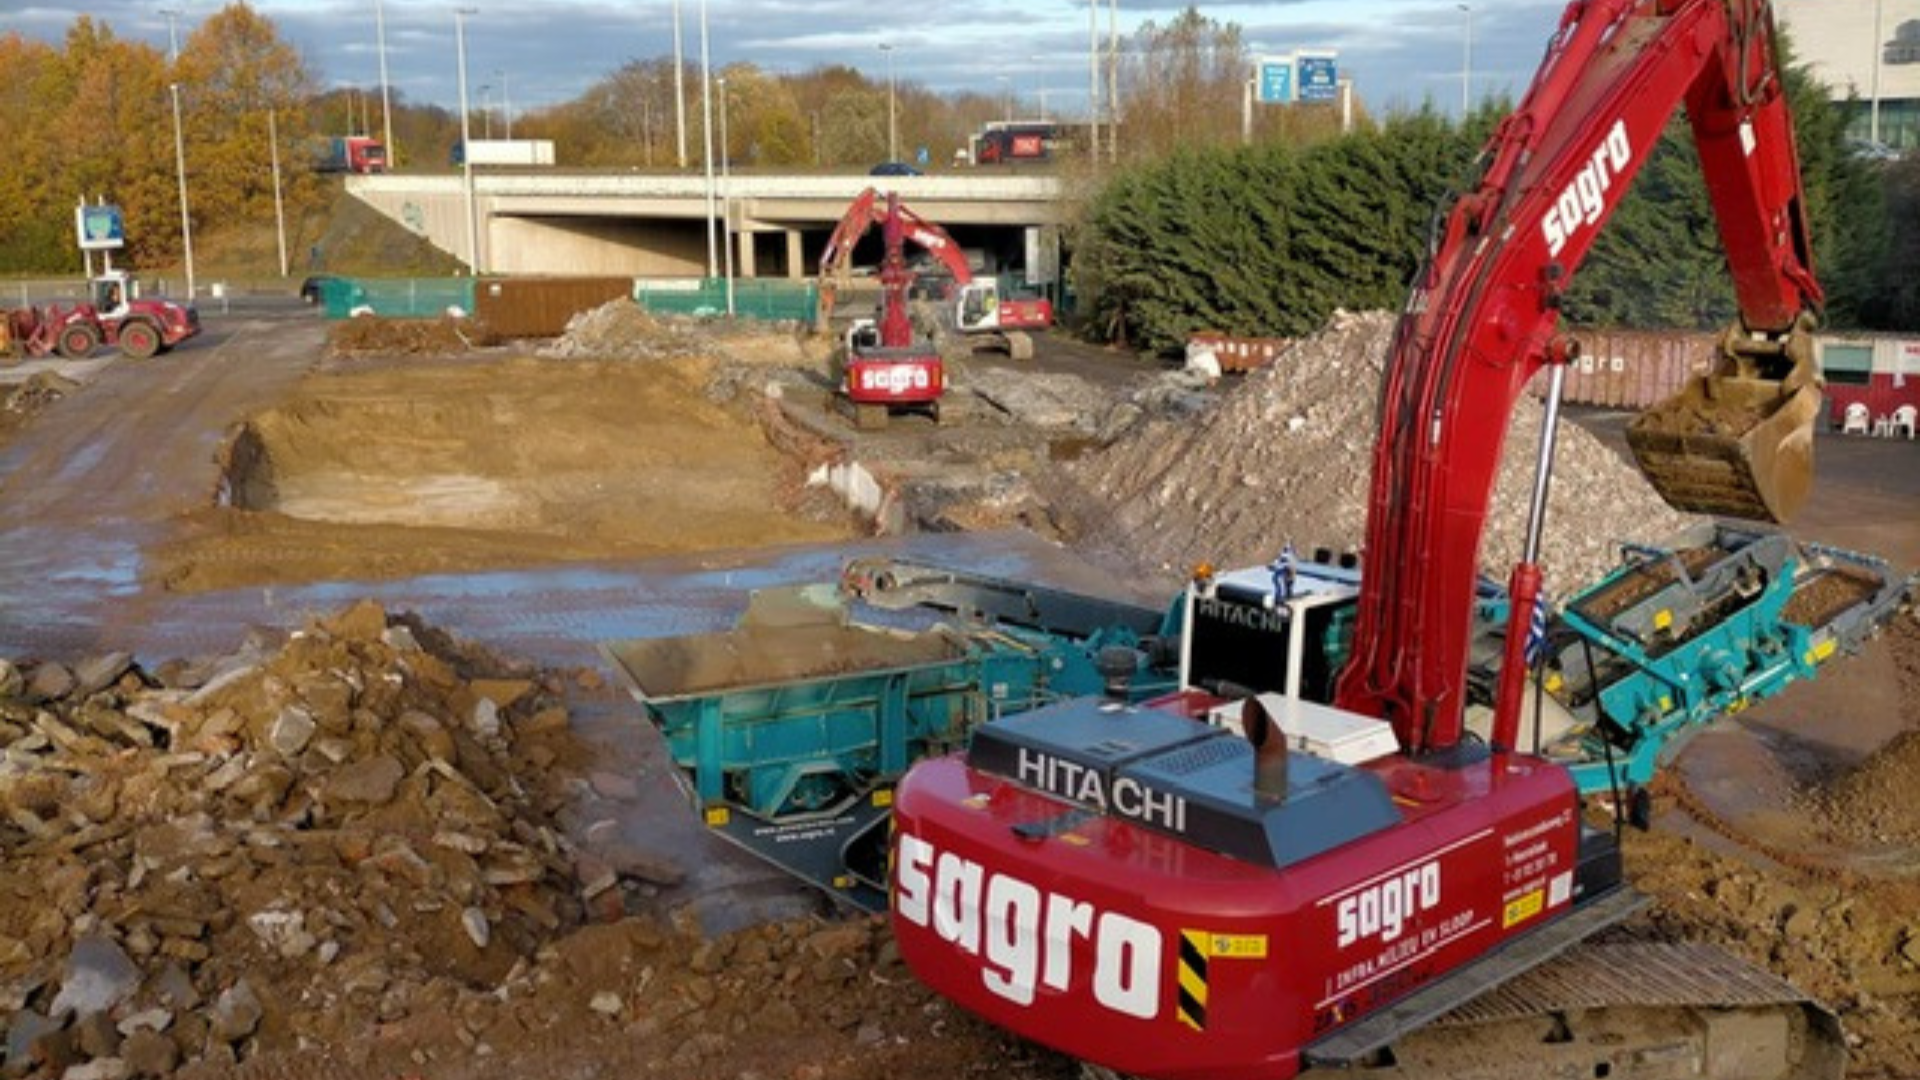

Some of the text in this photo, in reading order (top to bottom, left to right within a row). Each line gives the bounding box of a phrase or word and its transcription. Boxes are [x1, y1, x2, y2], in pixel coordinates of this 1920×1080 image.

[1541, 119, 1631, 258] sagro
[862, 363, 928, 394] sagro
[1198, 598, 1282, 632] HITACHI
[1018, 747, 1186, 832] HITACHI
[899, 832, 1163, 1019] sagro
[1337, 860, 1441, 949] sagro
[1439, 908, 1475, 938] SLOOP
